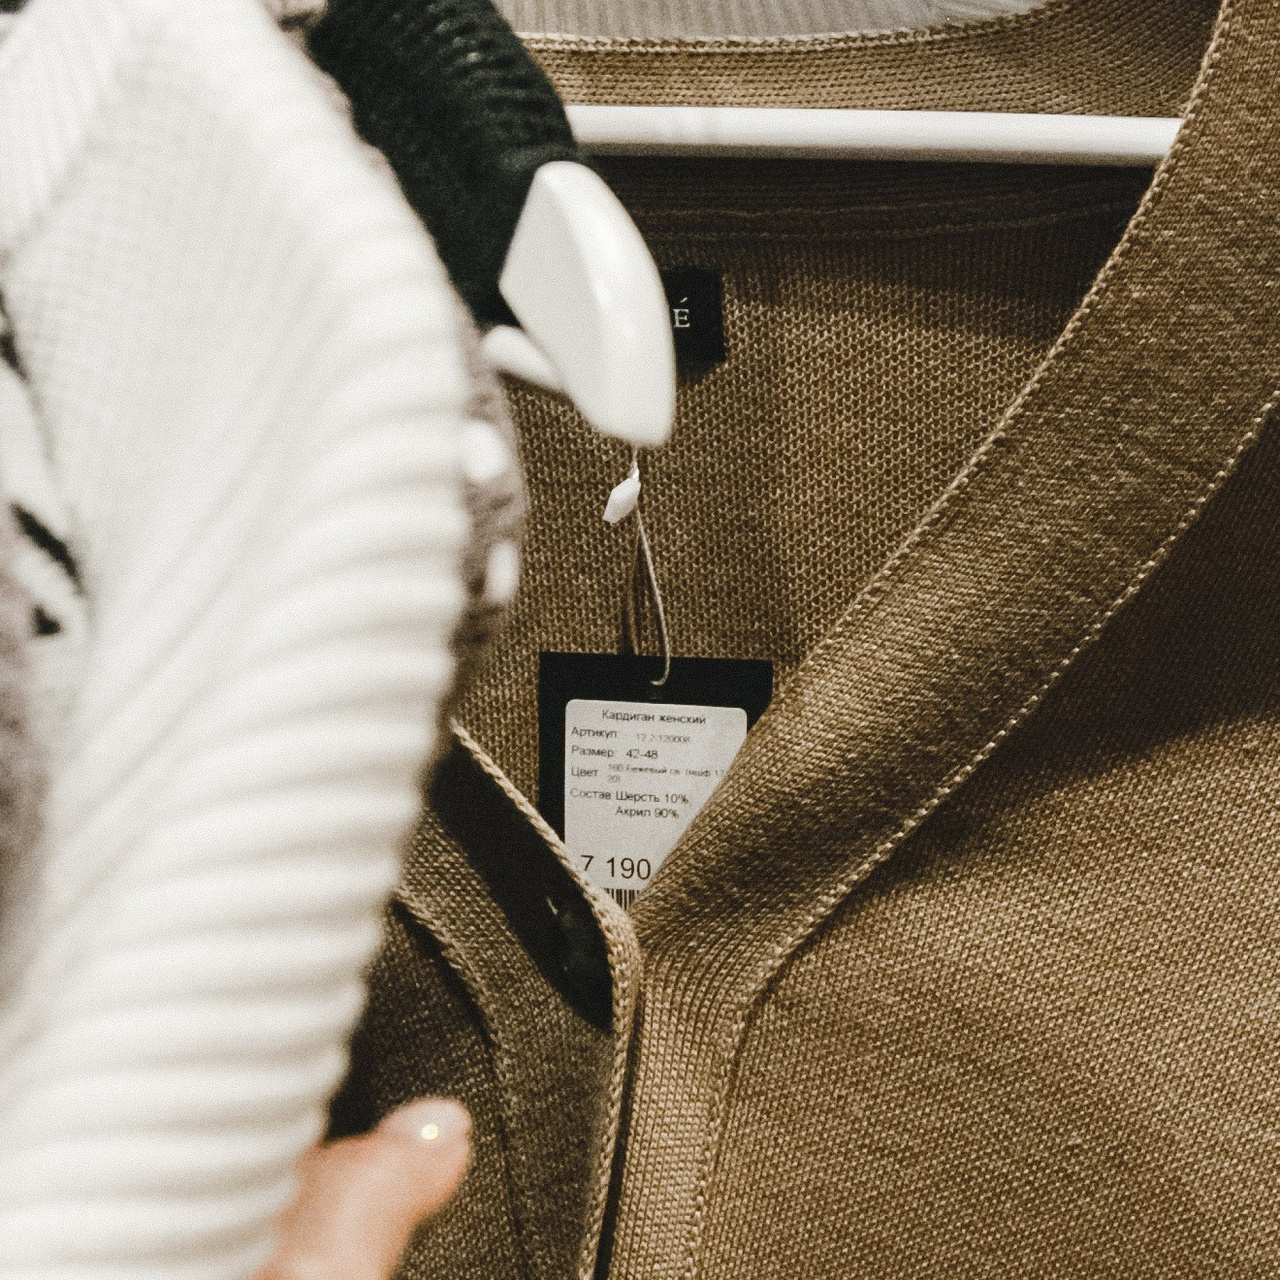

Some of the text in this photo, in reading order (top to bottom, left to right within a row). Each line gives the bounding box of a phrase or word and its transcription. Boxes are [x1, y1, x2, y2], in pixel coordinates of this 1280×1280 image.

[602, 709, 706, 724] Кардиган женский
[626, 749, 658, 760] 42-48
[616, 791, 660, 803] Шерсть
[616, 806, 680, 819] Акрил 90%
[581, 854, 651, 880] 7 190
